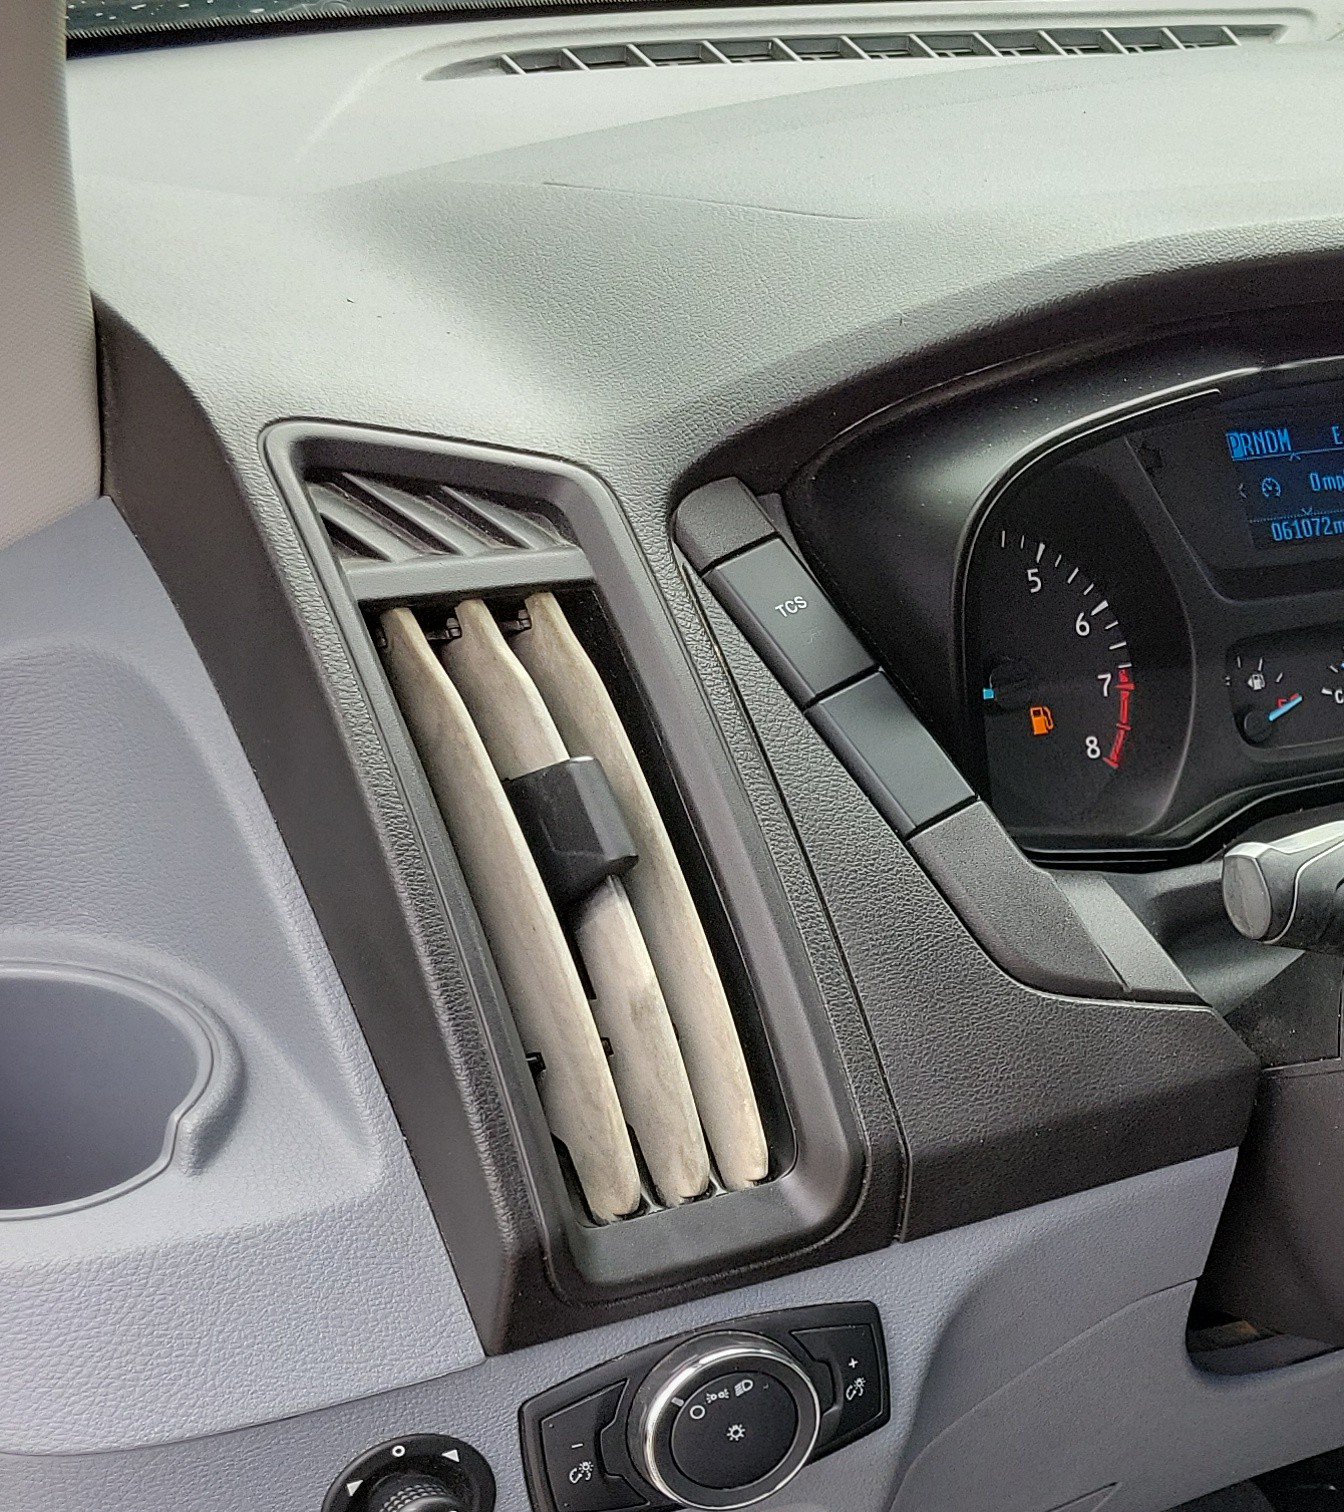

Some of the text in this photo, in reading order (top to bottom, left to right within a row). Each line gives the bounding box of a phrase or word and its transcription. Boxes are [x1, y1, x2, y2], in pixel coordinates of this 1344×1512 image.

[1228, 428, 1292, 457] PRNDM
[1331, 424, 1343, 445] E
[1026, 568, 1042, 593] 5
[774, 596, 807, 617] TCS
[1075, 612, 1090, 636] 6
[1097, 673, 1112, 697] 7
[1334, 688, 1344, 704] C
[1085, 736, 1100, 759] 8
